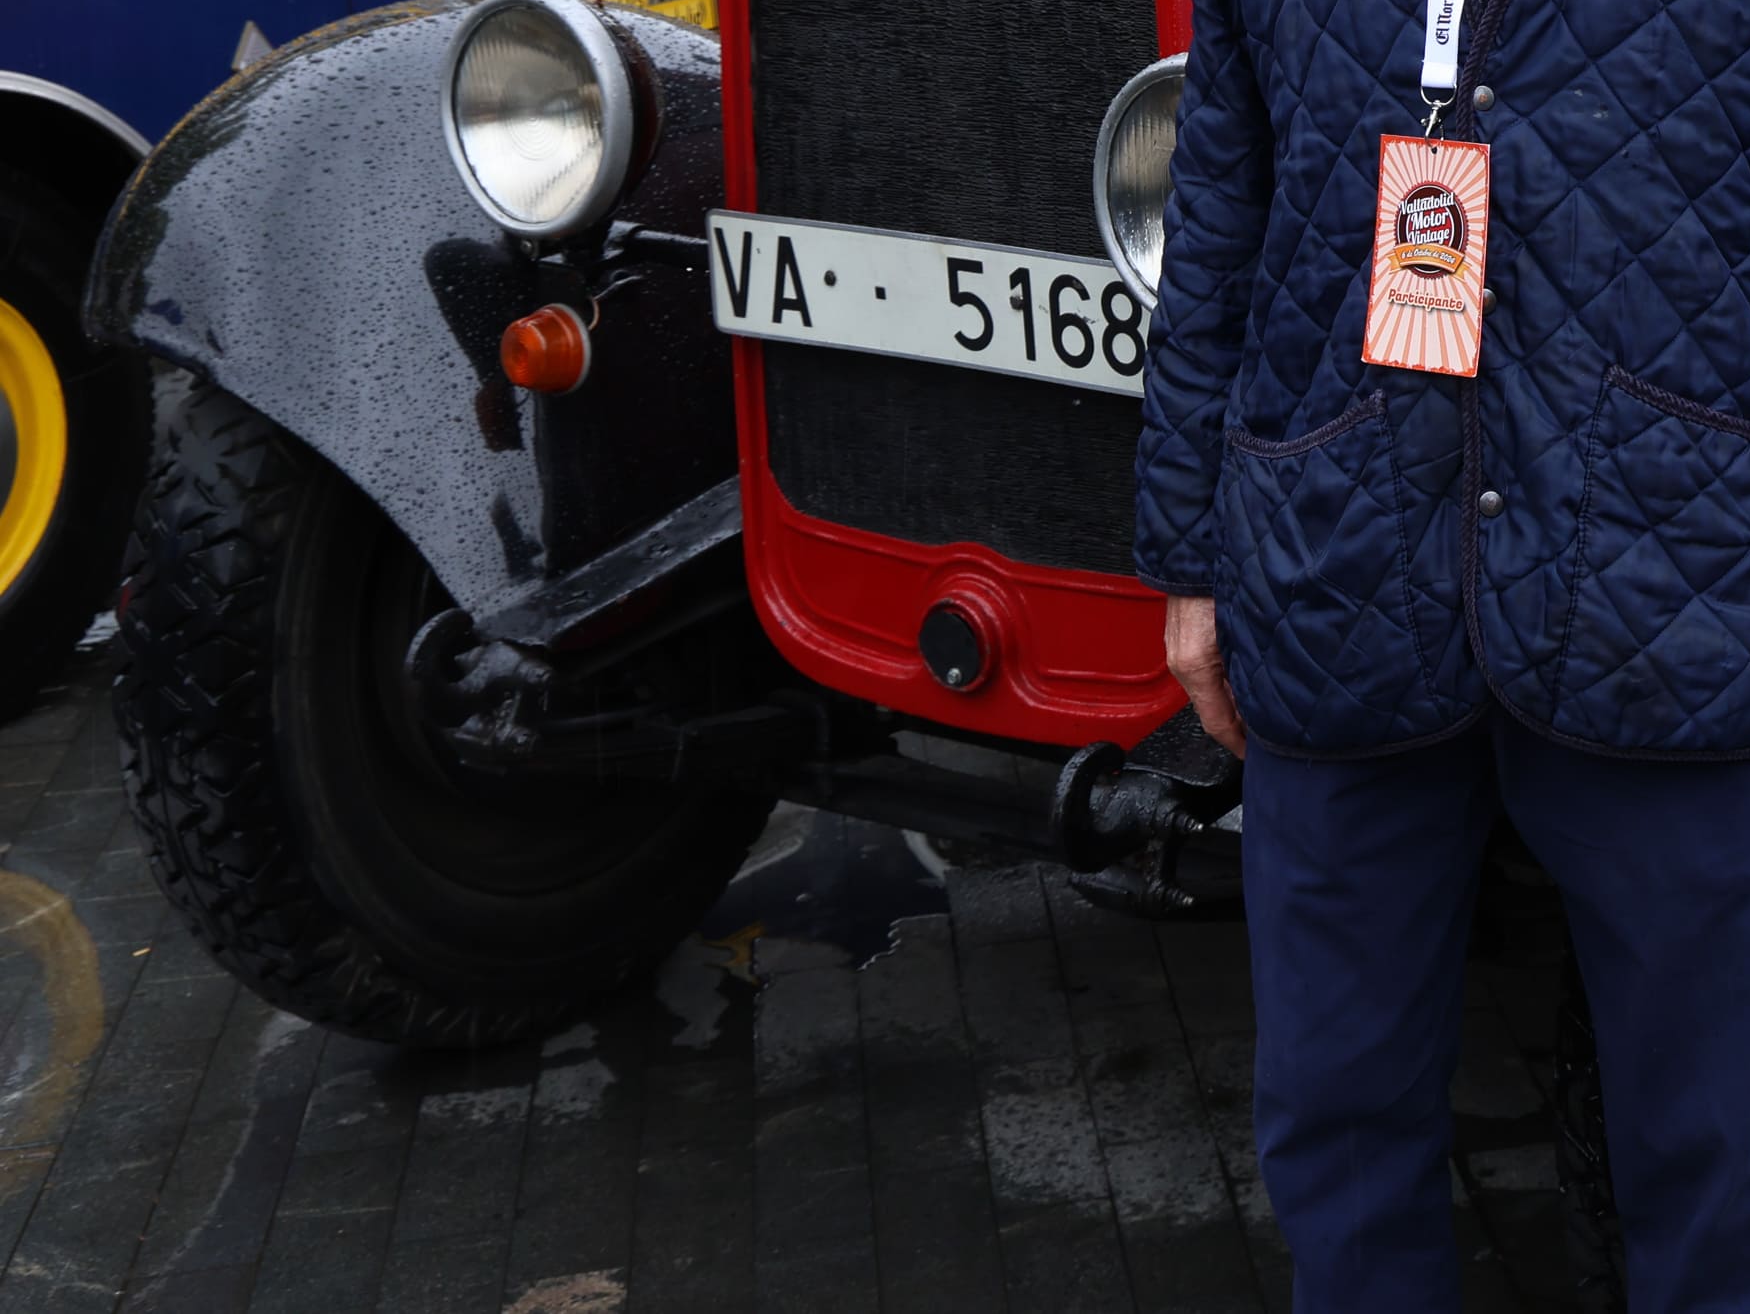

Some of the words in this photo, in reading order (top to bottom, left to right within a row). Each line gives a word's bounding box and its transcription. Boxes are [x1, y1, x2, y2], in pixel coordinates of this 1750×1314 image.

[1435, 27, 1450, 46] El
[1399, 191, 1455, 215] Valladolid
[1410, 210, 1450, 231] Motor
[1408, 228, 1450, 246] Vintage
[1388, 288, 1464, 311] Participante
[946, 256, 1146, 377] 5168
